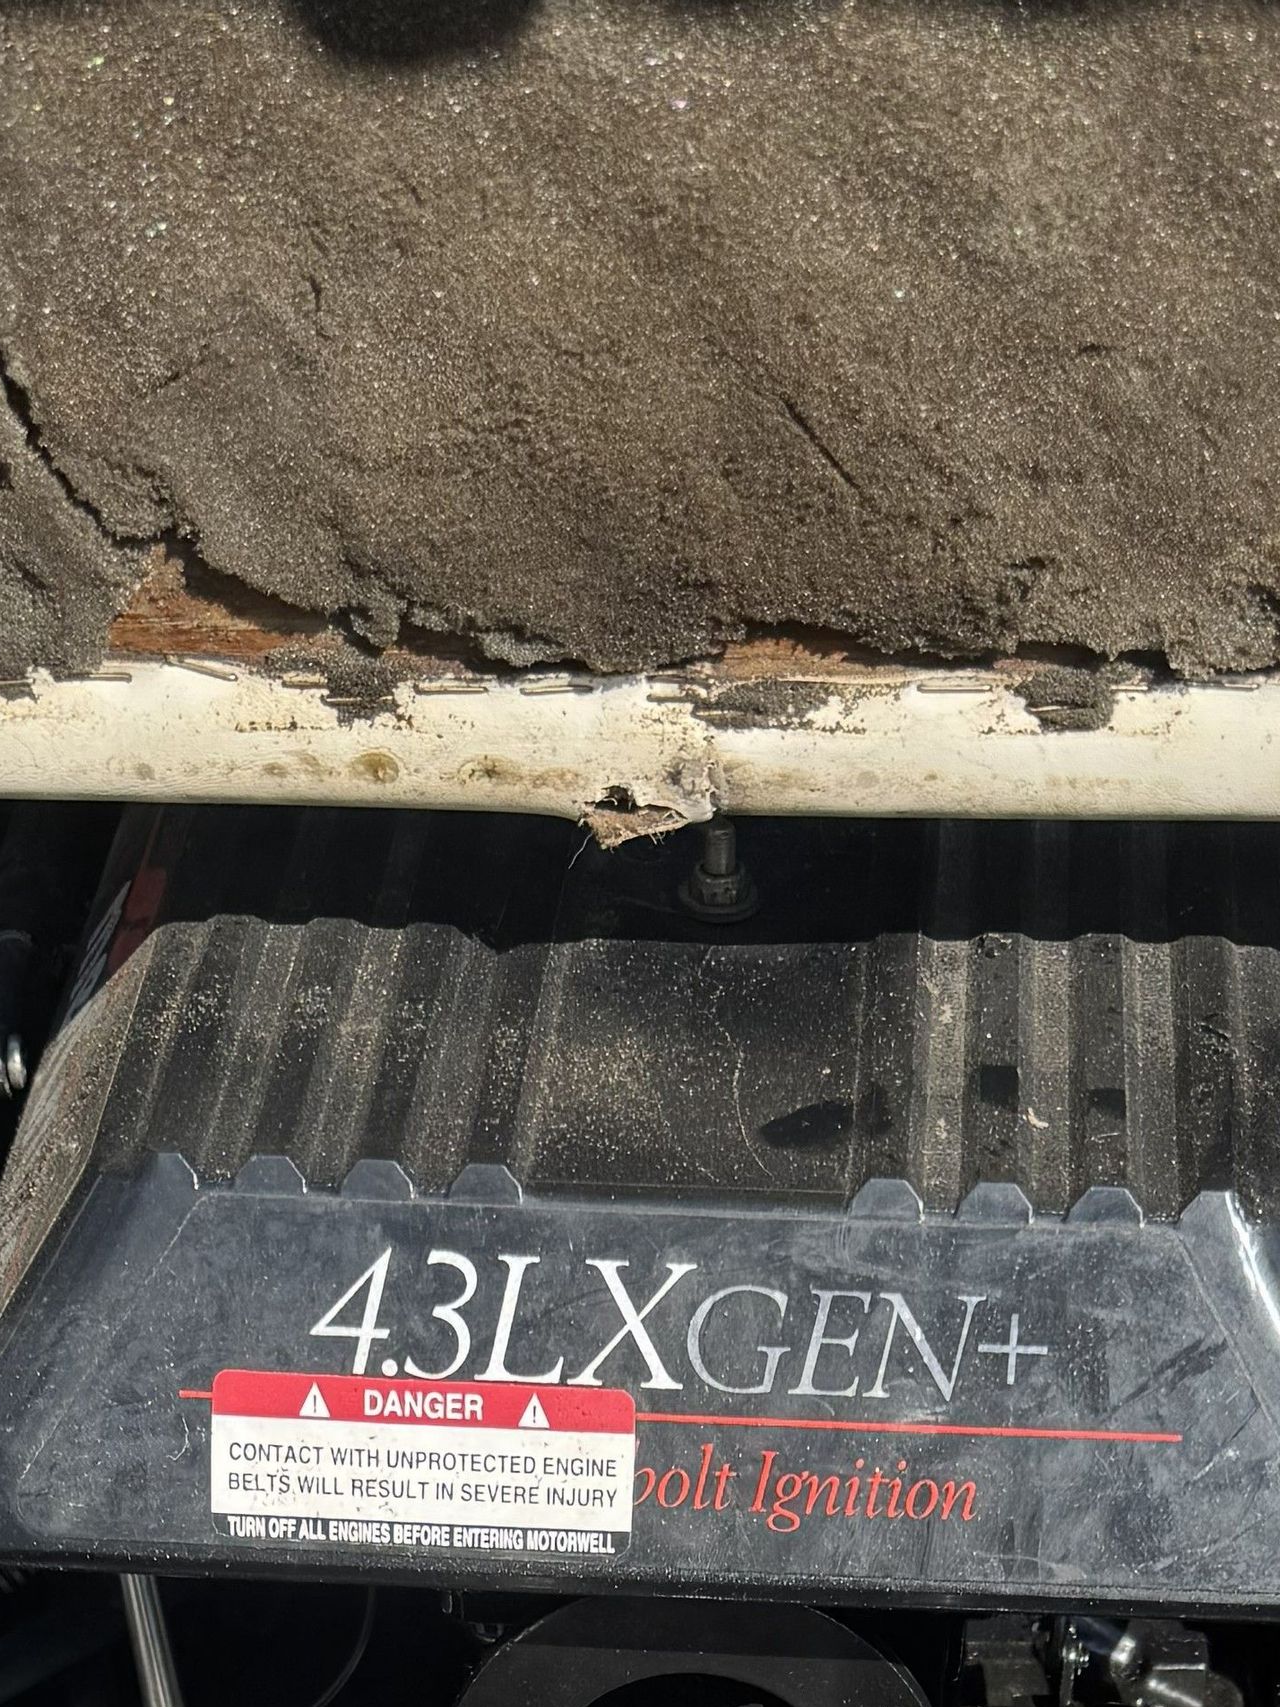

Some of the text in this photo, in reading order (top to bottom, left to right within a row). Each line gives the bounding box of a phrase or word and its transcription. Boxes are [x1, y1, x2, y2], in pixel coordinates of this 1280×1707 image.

[363, 1389, 484, 1421] DANGER
[228, 1442, 617, 1478] CONTACT WITH UNPROTECTED ENGINE
[228, 1472, 618, 1508] BELTS WILL RESULT IN SEVERE INJURY
[748, 1449, 978, 1532] Ignition
[227, 1516, 616, 1554] TURN OFF ALL ENGINES BEFORE ENTERING MOTORWELL
